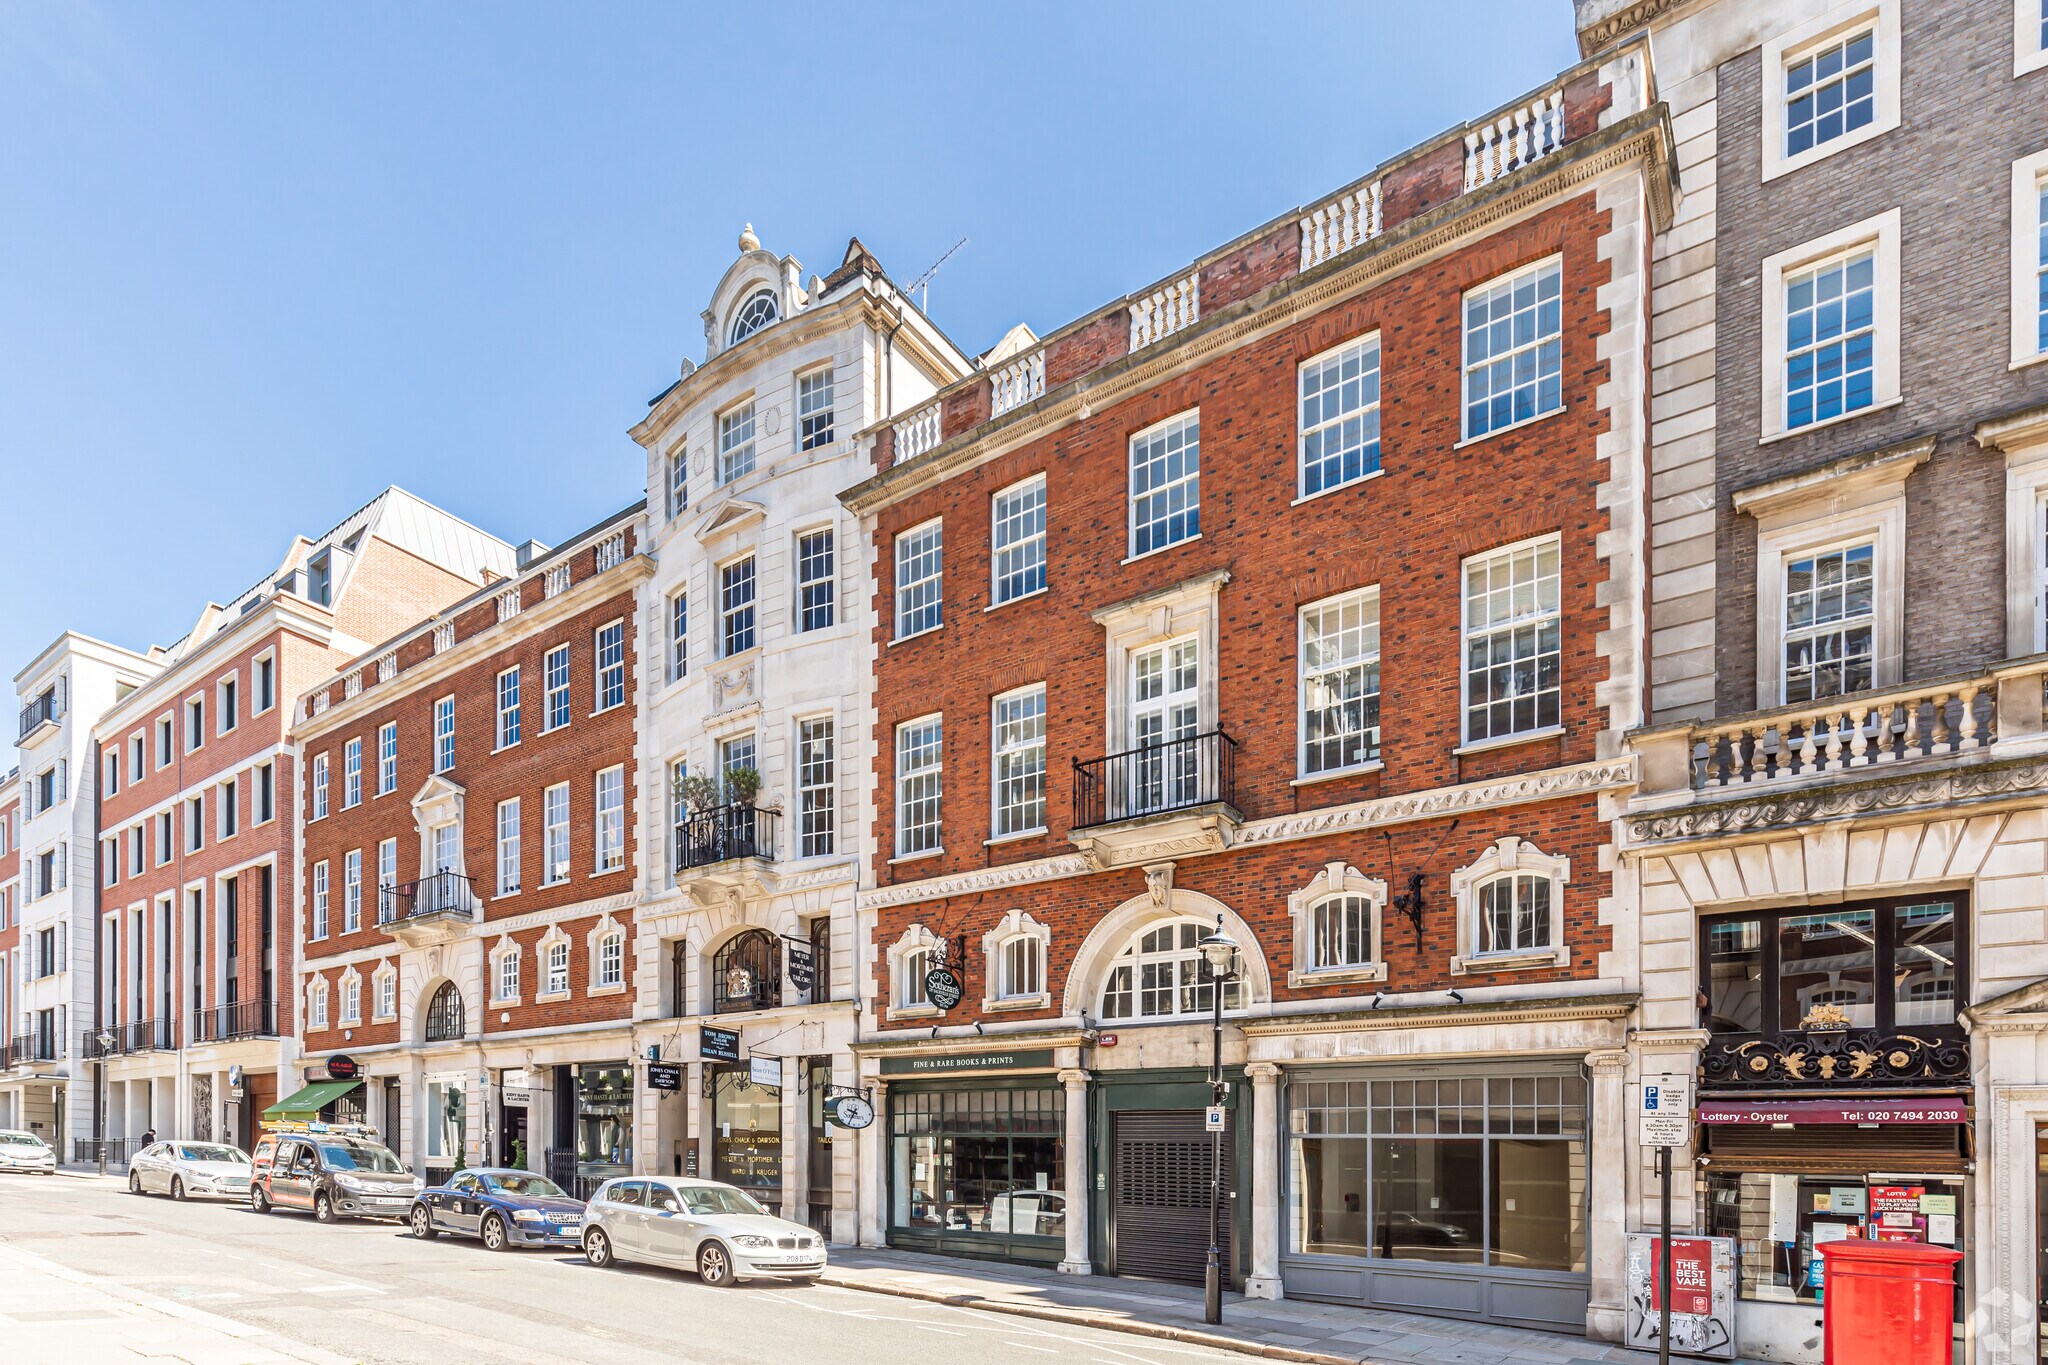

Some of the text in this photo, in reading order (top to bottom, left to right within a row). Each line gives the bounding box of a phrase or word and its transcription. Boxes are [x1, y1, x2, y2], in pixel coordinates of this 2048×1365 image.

[794, 951, 810, 961] MEYER
[790, 961, 814, 972] MORTIMER
[792, 975, 811, 984] TAILORS
[704, 1030, 736, 1041] TOM BROWN
[702, 1047, 738, 1059] BRIAN RUSSELL
[936, 1059, 955, 1067] RARE
[956, 1058, 980, 1066] BOOKS
[988, 1056, 1014, 1064] PRINTS
[752, 1066, 763, 1074] Sean
[1648, 1088, 1656, 1097] P
[1701, 1112, 1730, 1122] Lottery
[1750, 1112, 1789, 1122] Oyster
[1841, 1111, 1958, 1120] Tel: 020 7494 2030
[1675, 1261, 1699, 1270] THE
[1675, 1269, 1706, 1279] BEST
[1676, 1277, 1707, 1287] VAPE
